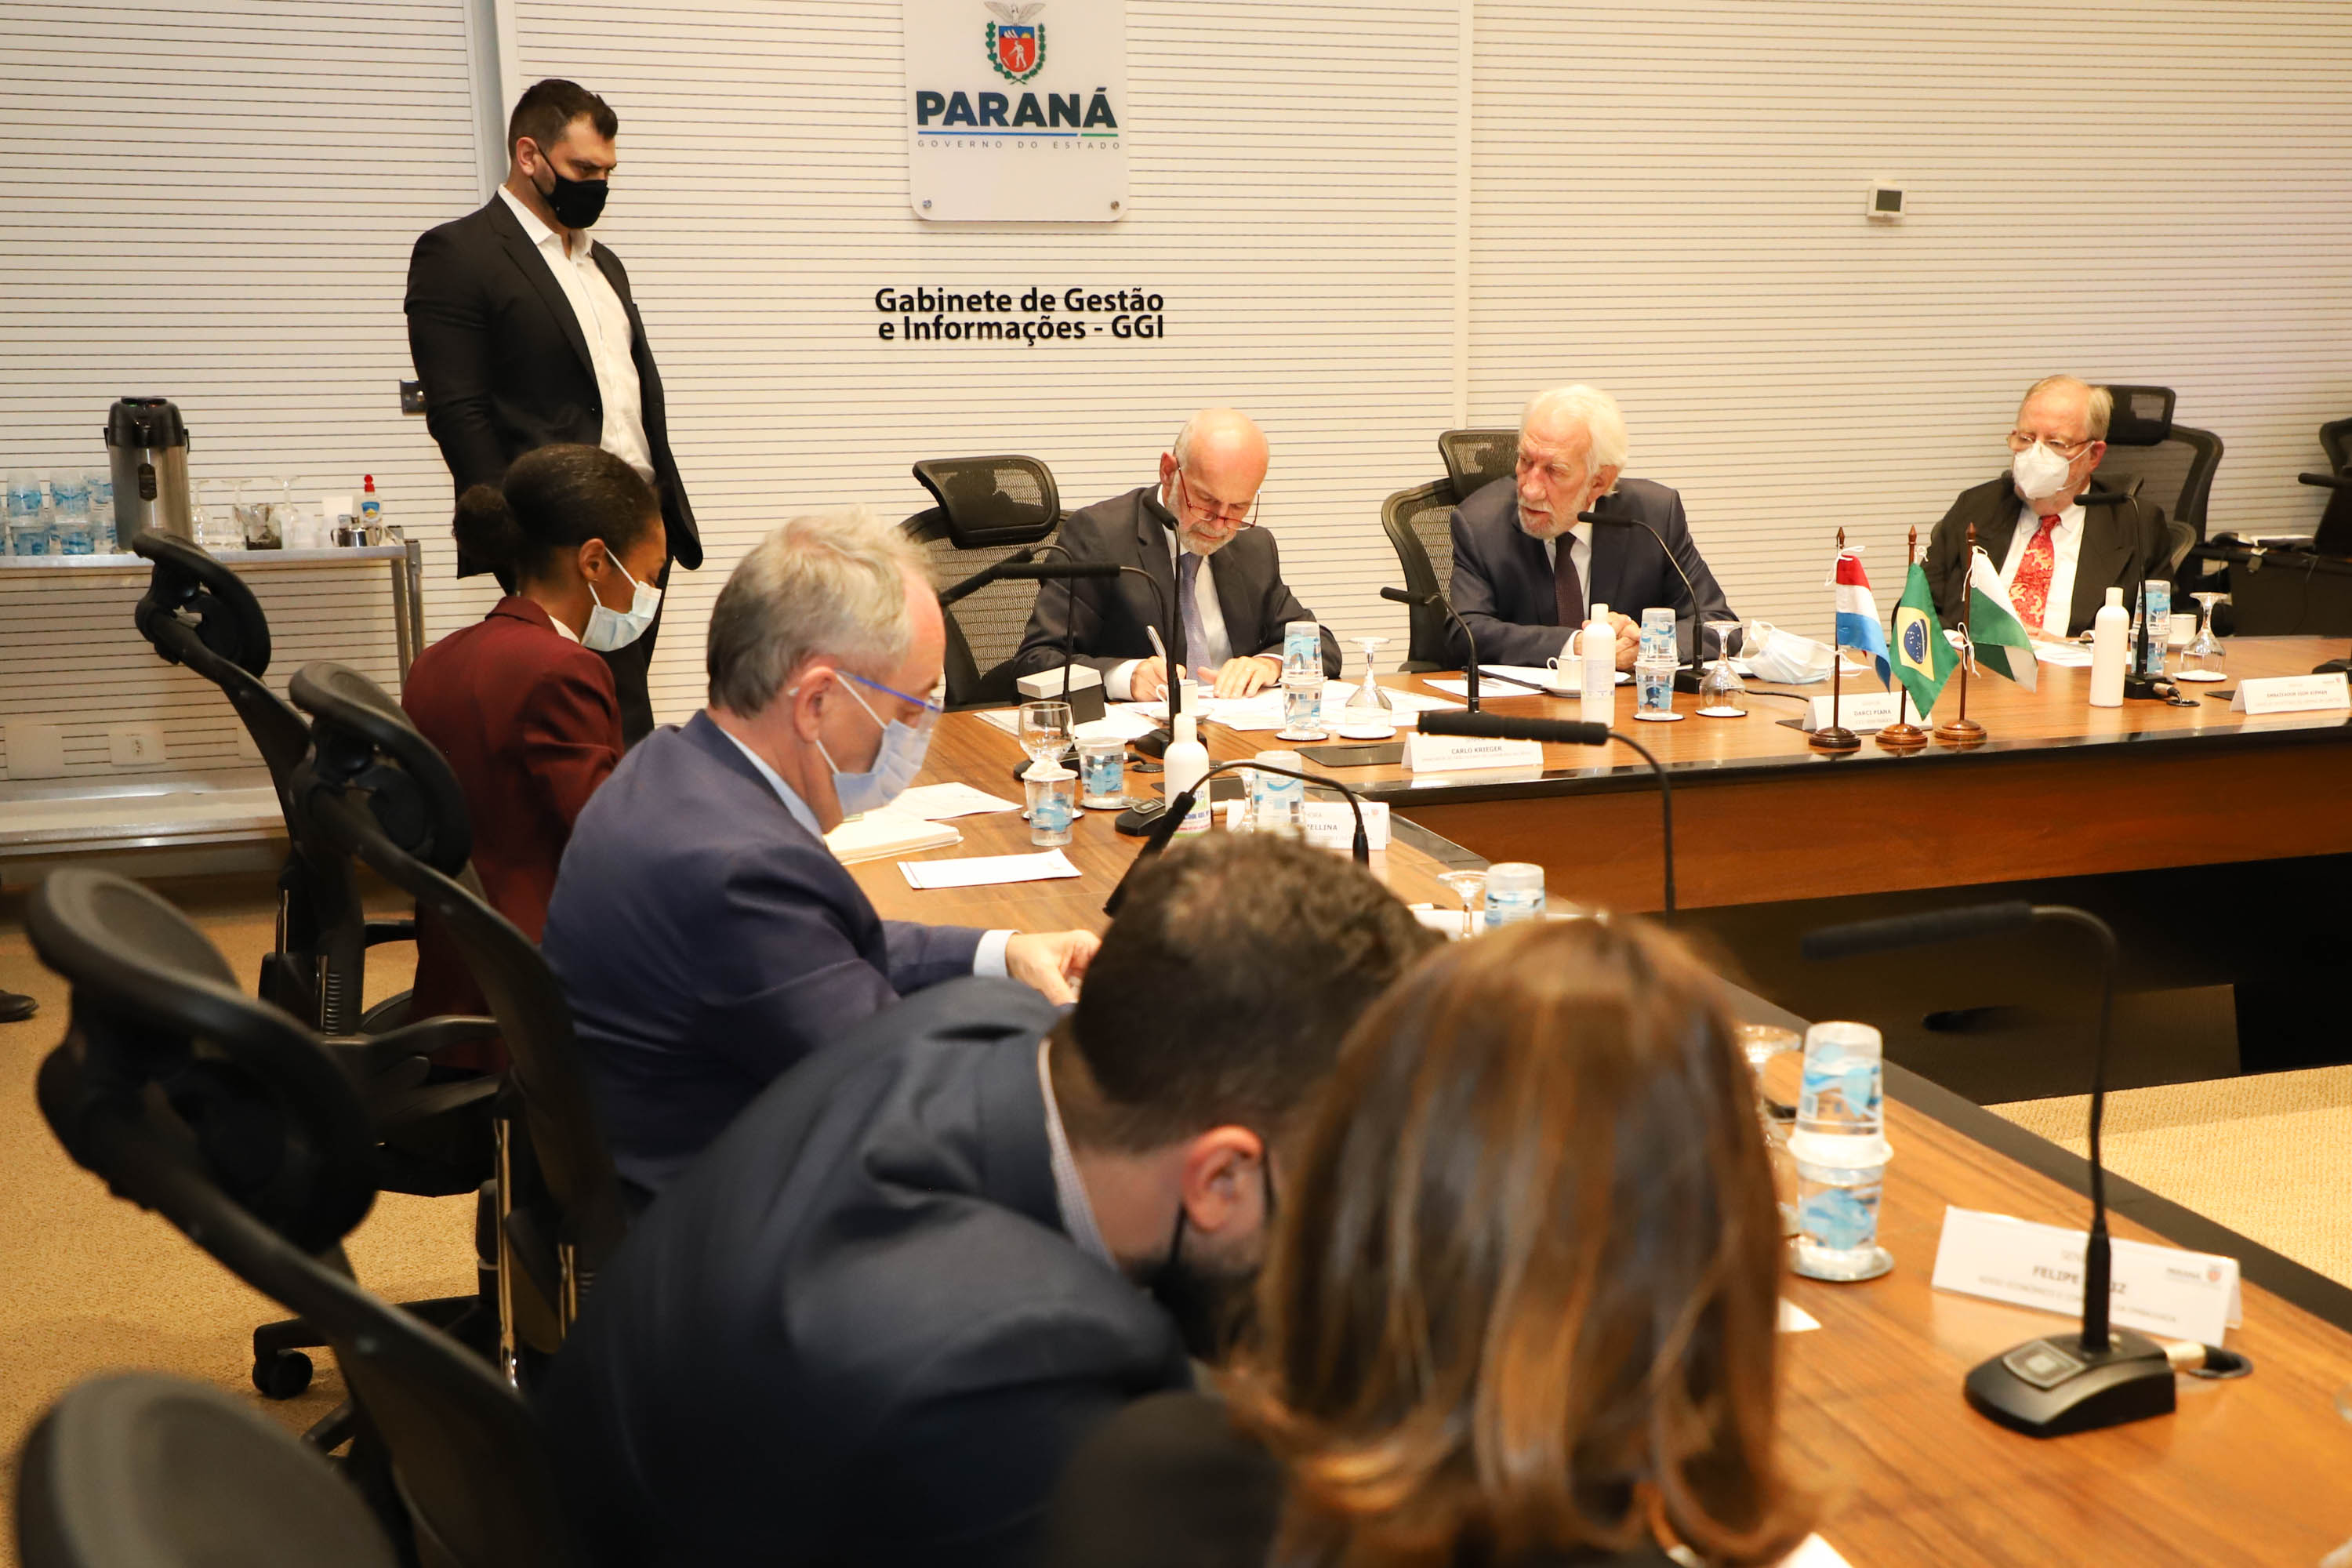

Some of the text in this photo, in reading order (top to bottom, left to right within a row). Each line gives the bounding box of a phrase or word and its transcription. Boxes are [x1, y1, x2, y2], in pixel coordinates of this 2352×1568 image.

[916, 87, 1118, 128] PARANÁ
[917, 140, 1120, 150] GOVERNO DO ESTADO
[875, 287, 1163, 313] Gabinete de Gestão
[878, 323, 895, 339] e
[904, 315, 1086, 346] Informações
[1111, 315, 1163, 339] GGI
[2032, 1265, 2079, 1284] FELIPE
